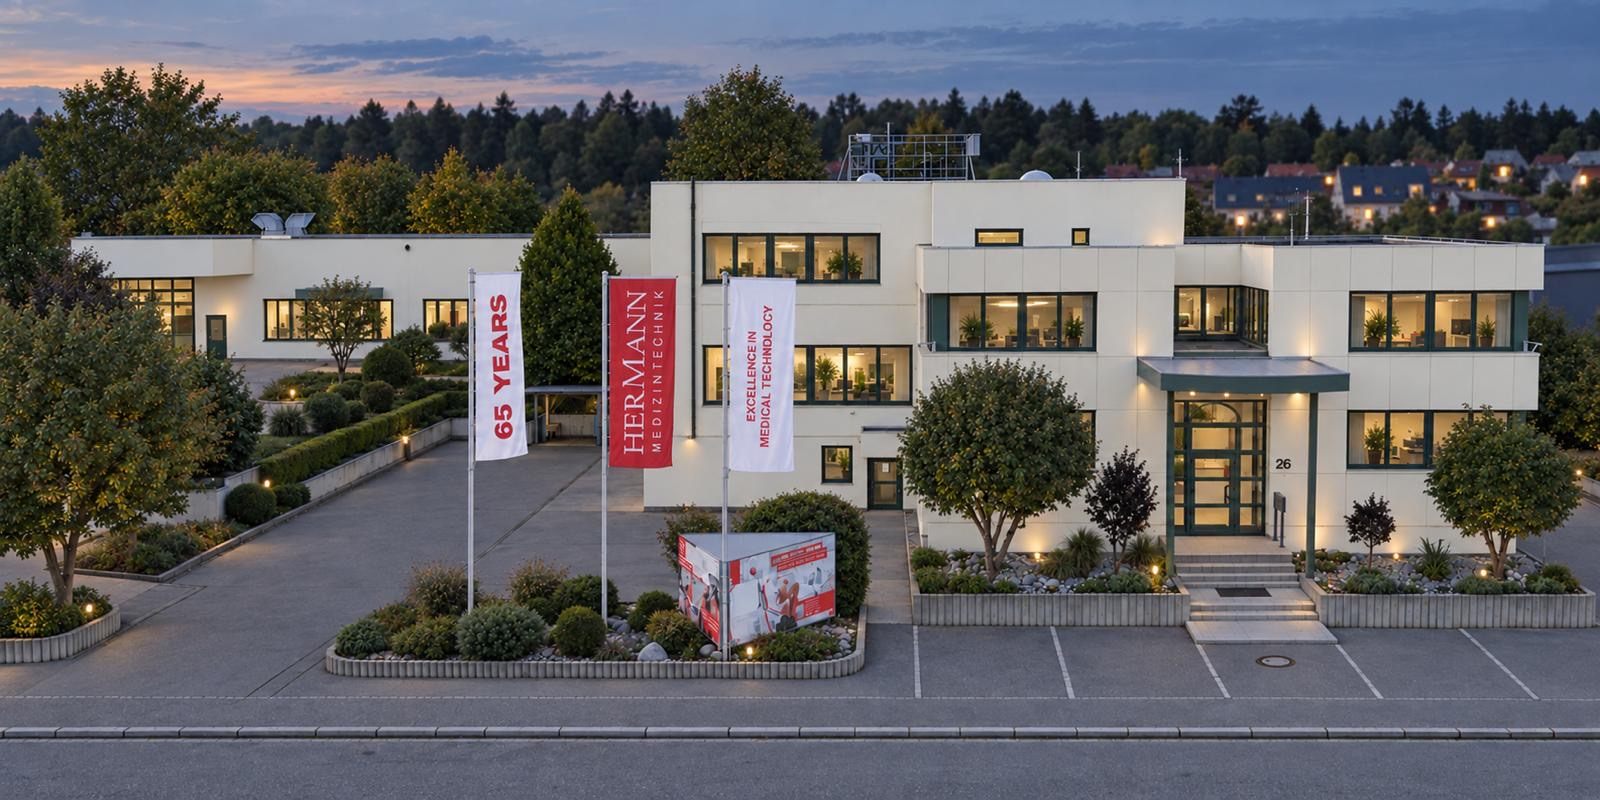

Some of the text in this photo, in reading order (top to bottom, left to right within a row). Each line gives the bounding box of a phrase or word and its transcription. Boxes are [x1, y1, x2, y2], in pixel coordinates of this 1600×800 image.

[489, 294, 513, 440] 65 YEARS
[622, 290, 647, 455] HERMANN
[652, 290, 664, 453] MEDIZINTECHNIK
[746, 331, 757, 422] EXCELLENCE IN
[760, 393, 771, 448] MEDICAL
[1275, 458, 1292, 470] 26
